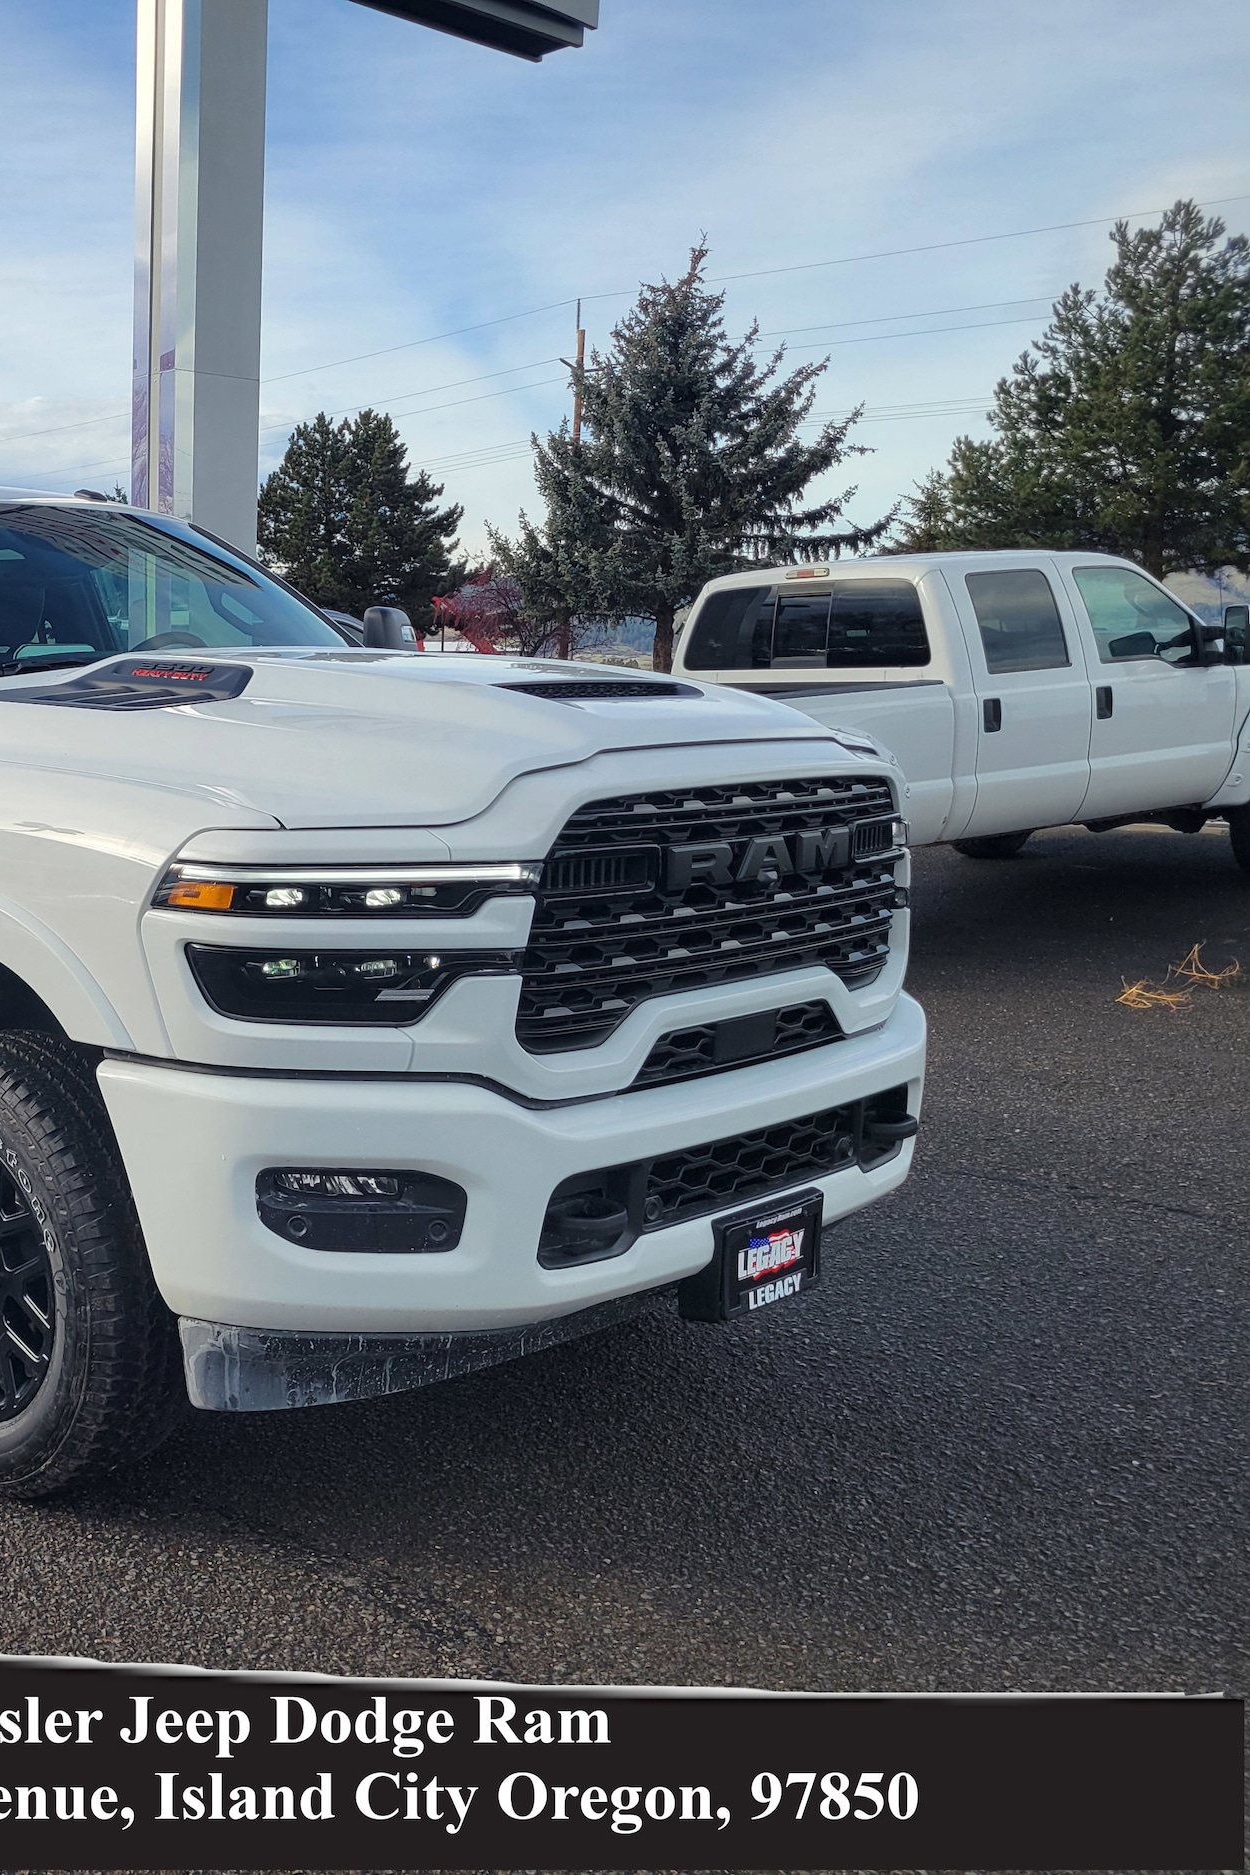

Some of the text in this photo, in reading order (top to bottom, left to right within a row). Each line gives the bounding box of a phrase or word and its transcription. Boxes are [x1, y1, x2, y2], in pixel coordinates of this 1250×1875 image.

[132, 668, 209, 681] HEAVY DUTY
[667, 826, 850, 891] RAM
[738, 1230, 805, 1279] LEGACY
[748, 1273, 801, 1310] LEGACY
